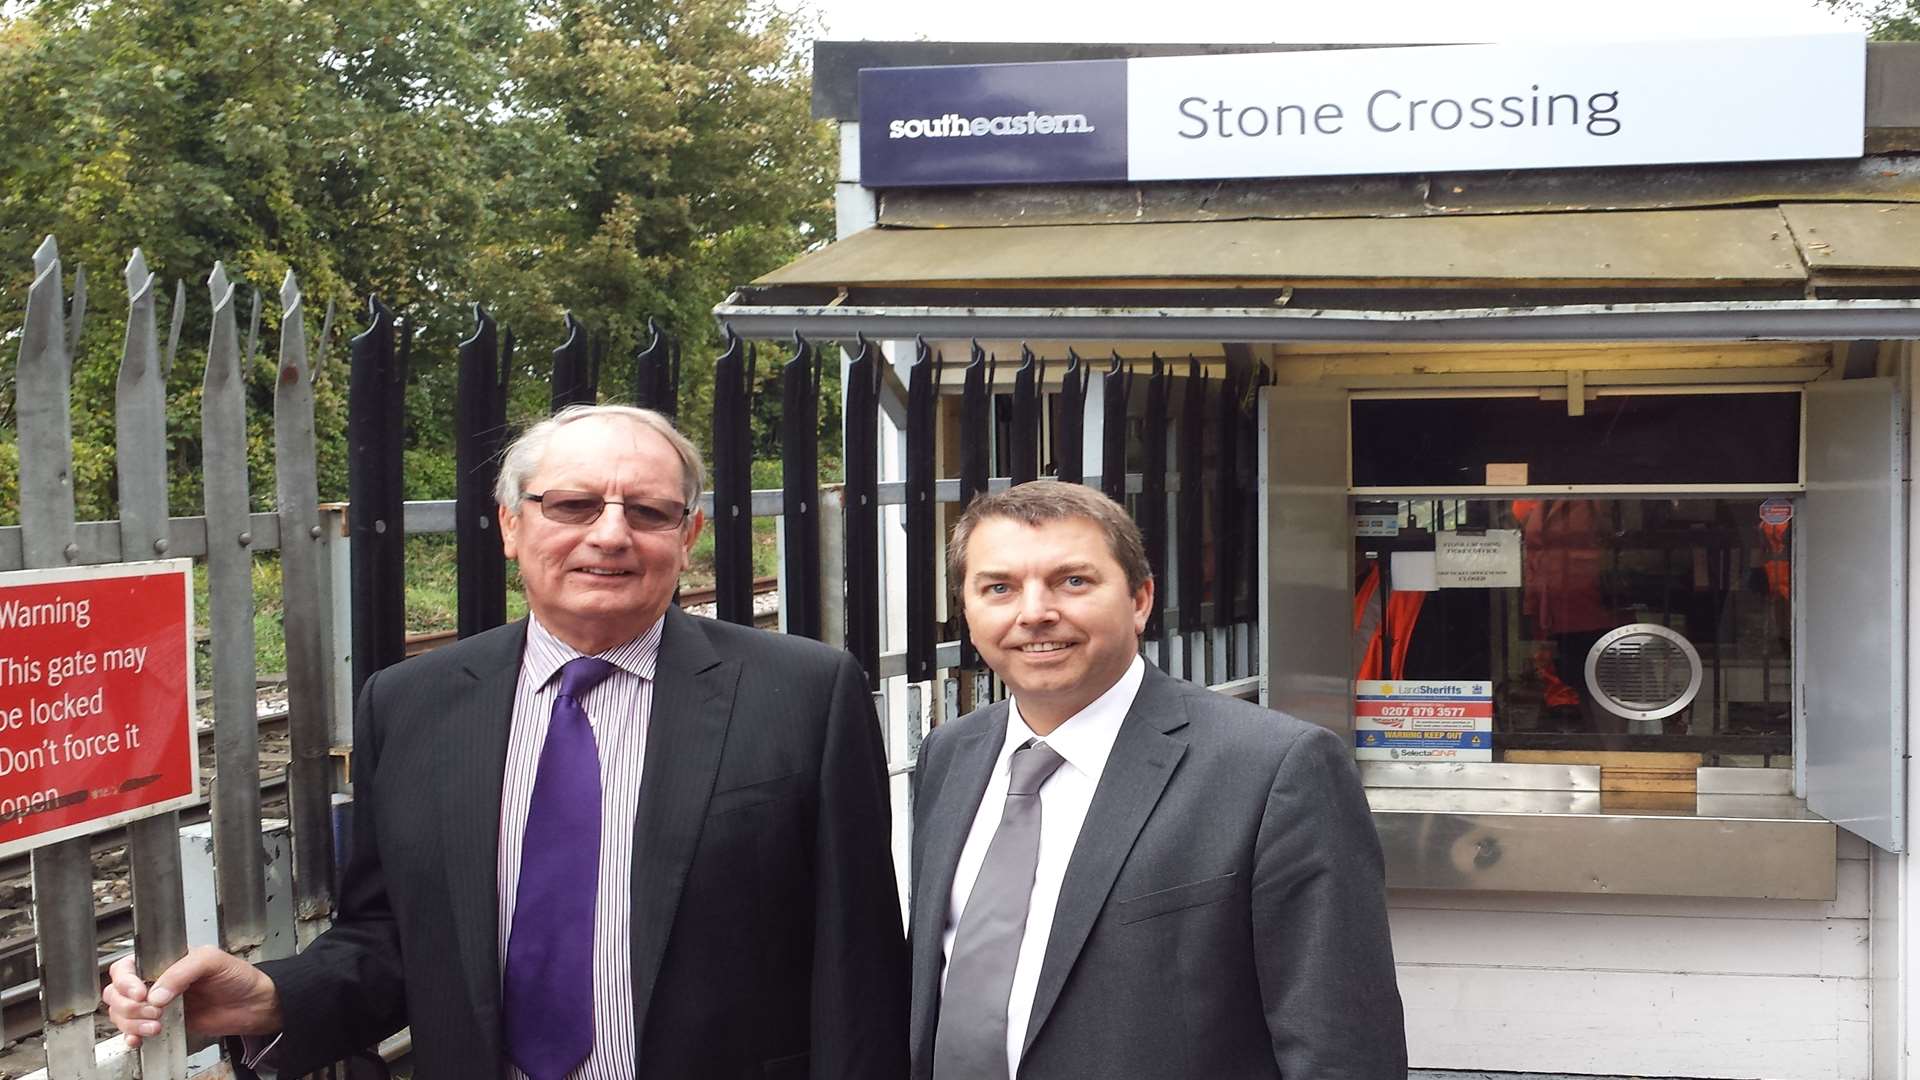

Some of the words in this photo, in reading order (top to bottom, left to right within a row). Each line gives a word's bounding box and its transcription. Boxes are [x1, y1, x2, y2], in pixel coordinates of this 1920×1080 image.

[1178, 95, 1344, 139] Stone
[1366, 84, 1622, 137] Crossing
[0, 596, 91, 628] Warning
[48, 651, 96, 687] gate
[103, 646, 147, 674] may
[30, 687, 103, 726] locked
[1398, 685, 1462, 695] LandSheriffs
[1381, 706, 1409, 716] 0207
[1412, 707, 1434, 716] 979
[1436, 707, 1466, 717] 3577
[0, 737, 58, 776] Don't
[63, 731, 121, 763] force
[125, 724, 140, 748] it
[1384, 731, 1422, 739] WARNING
[1424, 731, 1445, 739] KEEP
[1446, 731, 1463, 740] OUT
[0, 786, 59, 824] open
